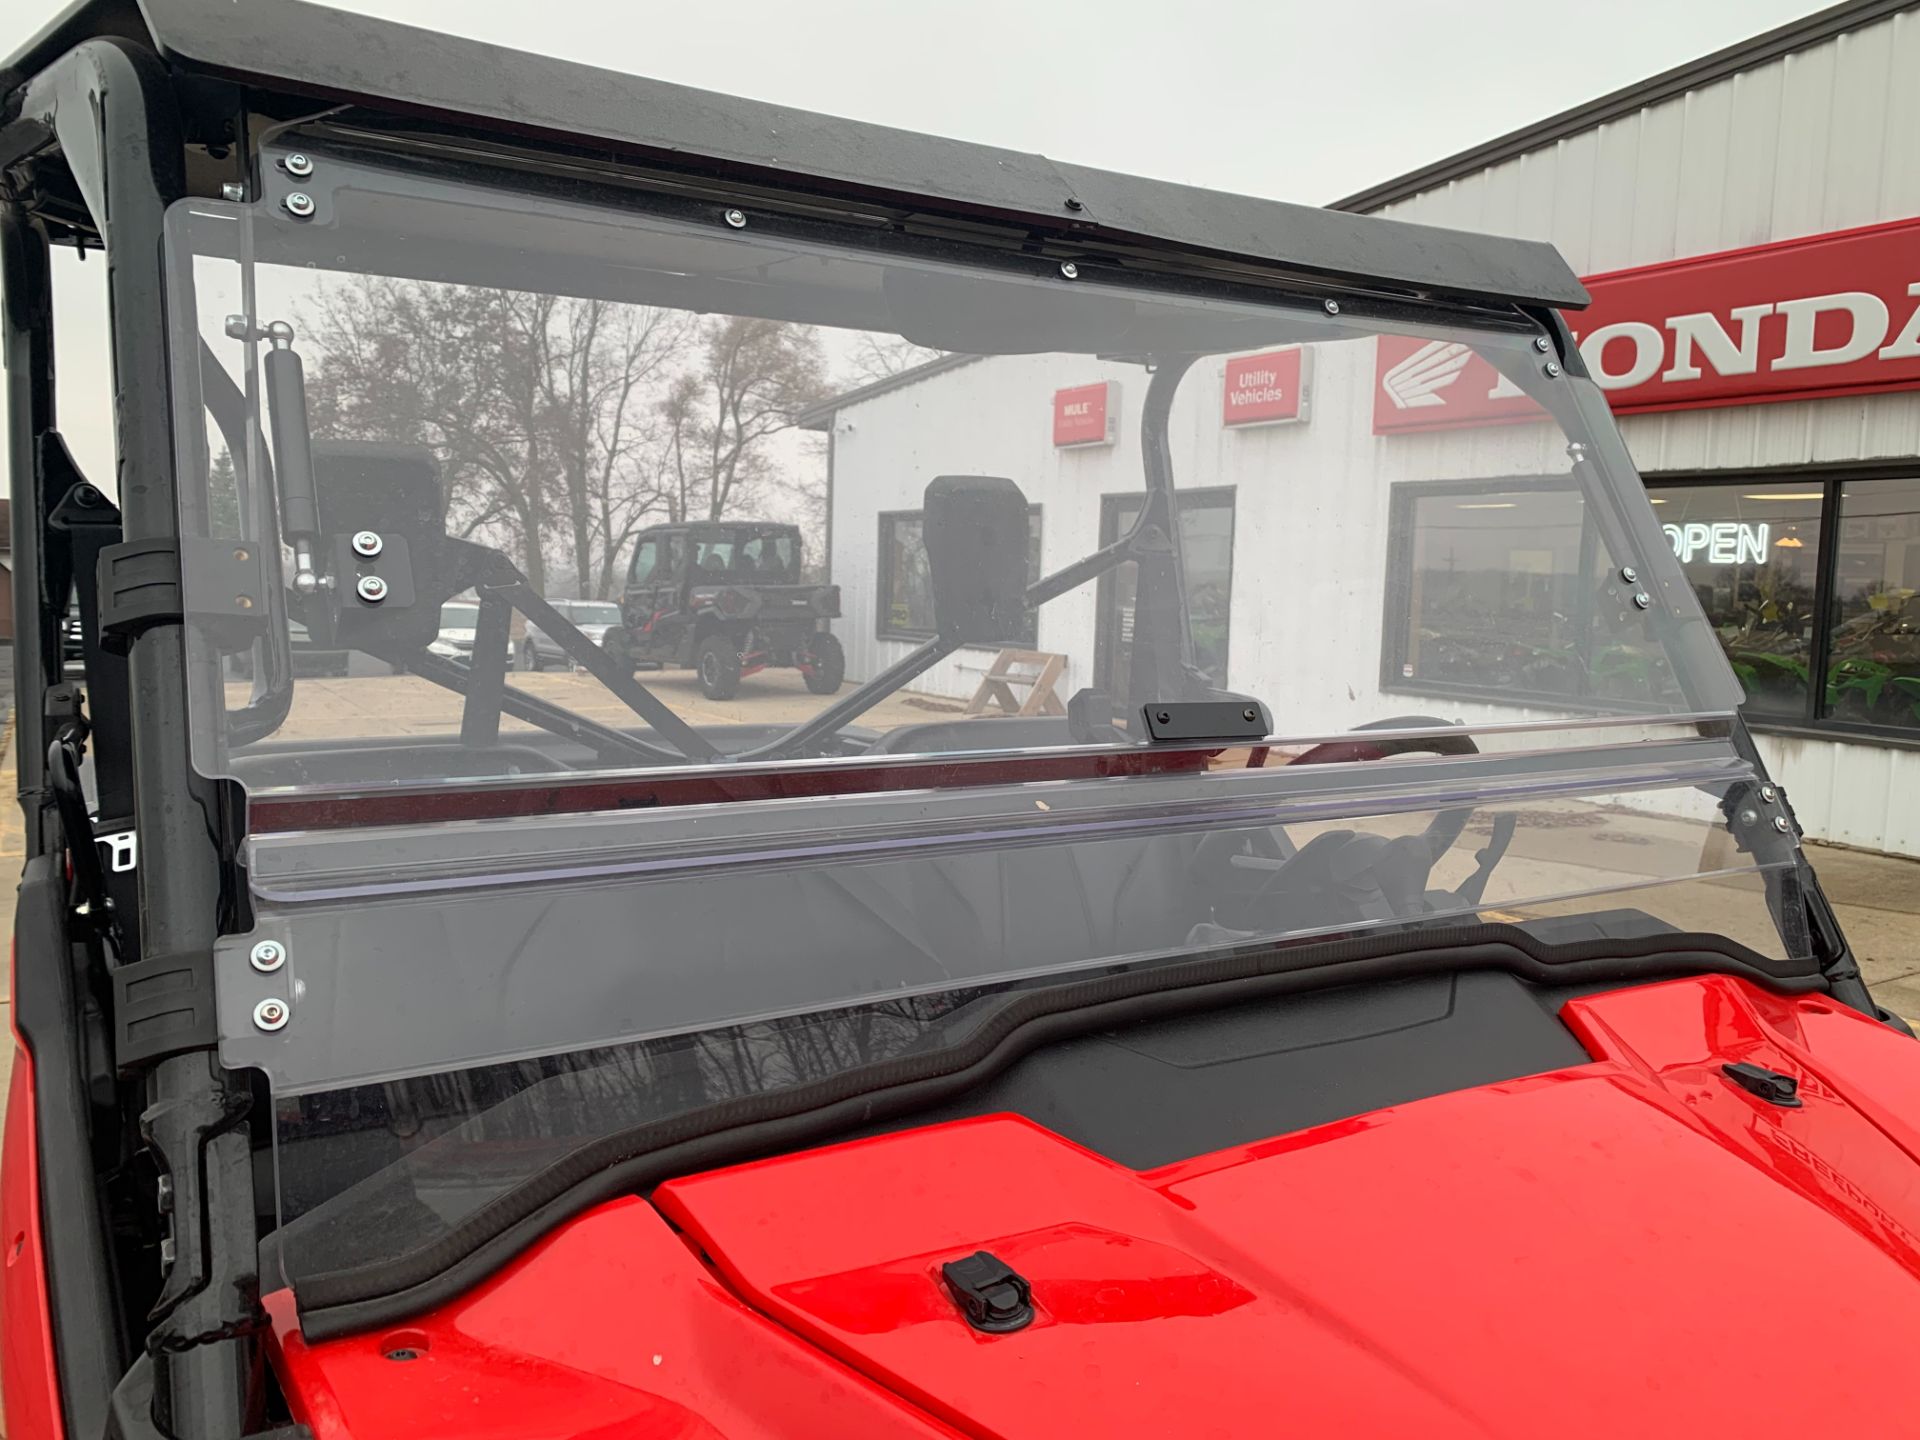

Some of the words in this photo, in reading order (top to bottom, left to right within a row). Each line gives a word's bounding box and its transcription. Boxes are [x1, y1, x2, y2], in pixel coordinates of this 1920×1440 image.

[1488, 282, 1920, 399] OND
[1239, 370, 1277, 388] Utility
[1230, 387, 1282, 406] Vehicles
